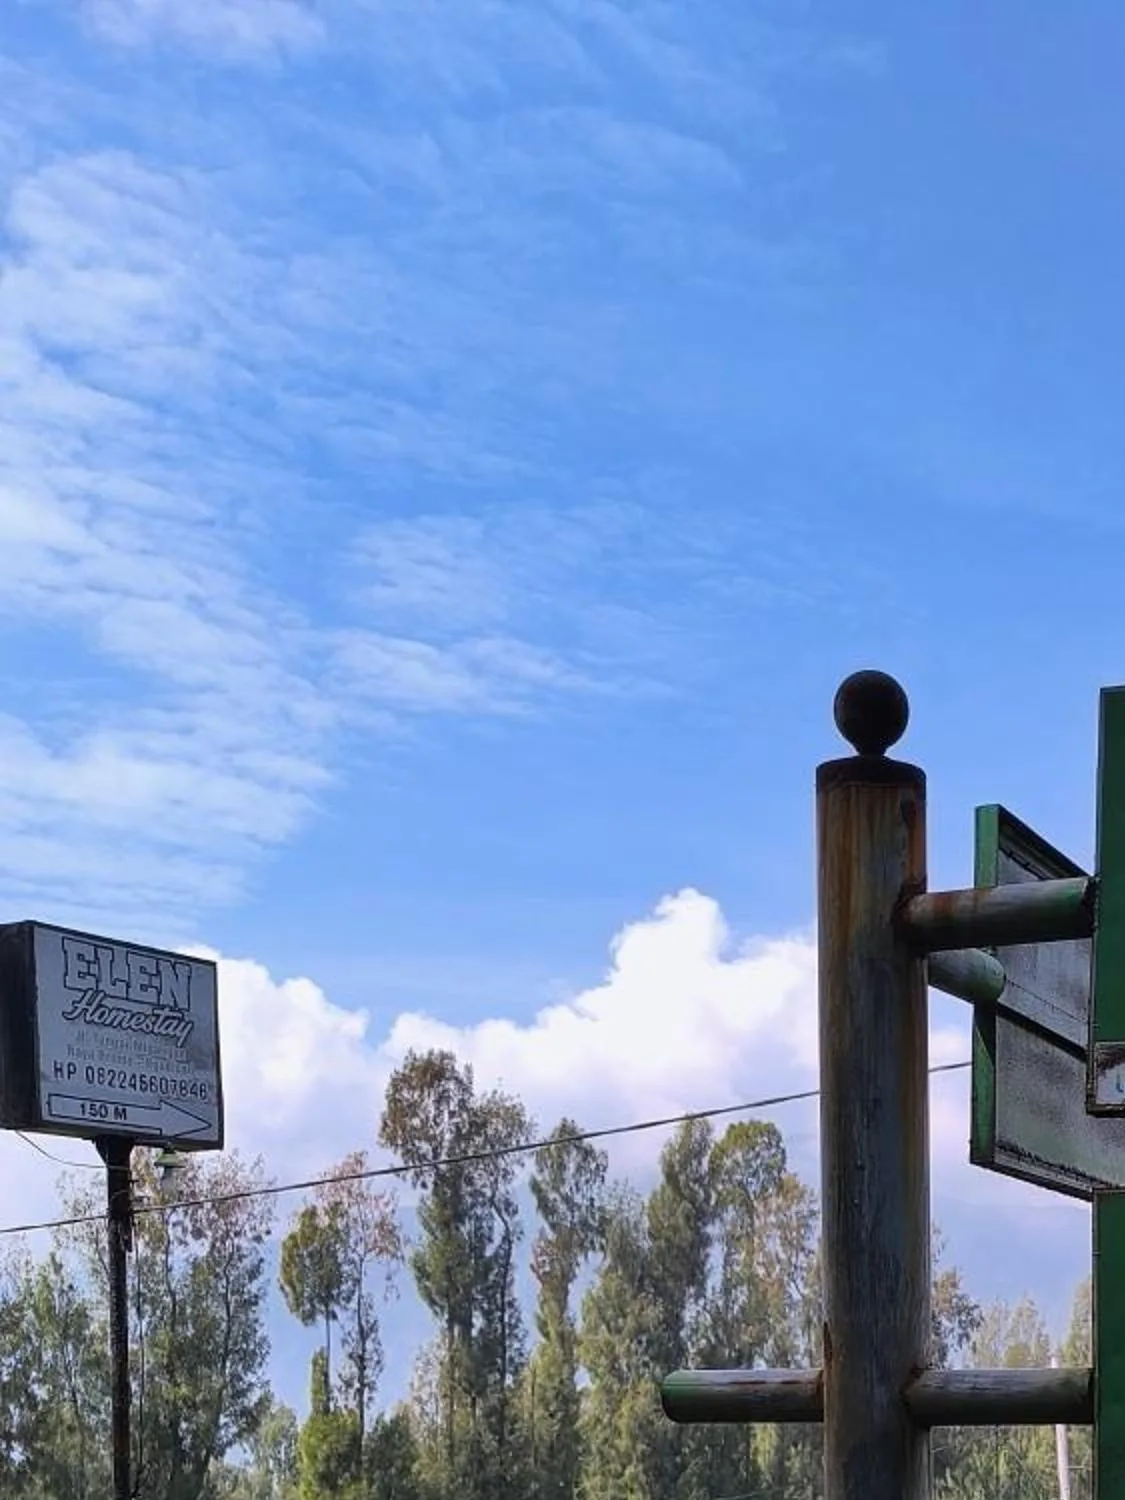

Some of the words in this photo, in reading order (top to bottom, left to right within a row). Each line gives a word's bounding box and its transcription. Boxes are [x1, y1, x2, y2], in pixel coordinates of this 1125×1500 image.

[62, 936, 193, 1012] ELEN
[62, 987, 195, 1049] Homestay
[53, 1060, 77, 1080] HP
[80, 1103, 109, 1118] 150
[113, 1105, 127, 1121] M
